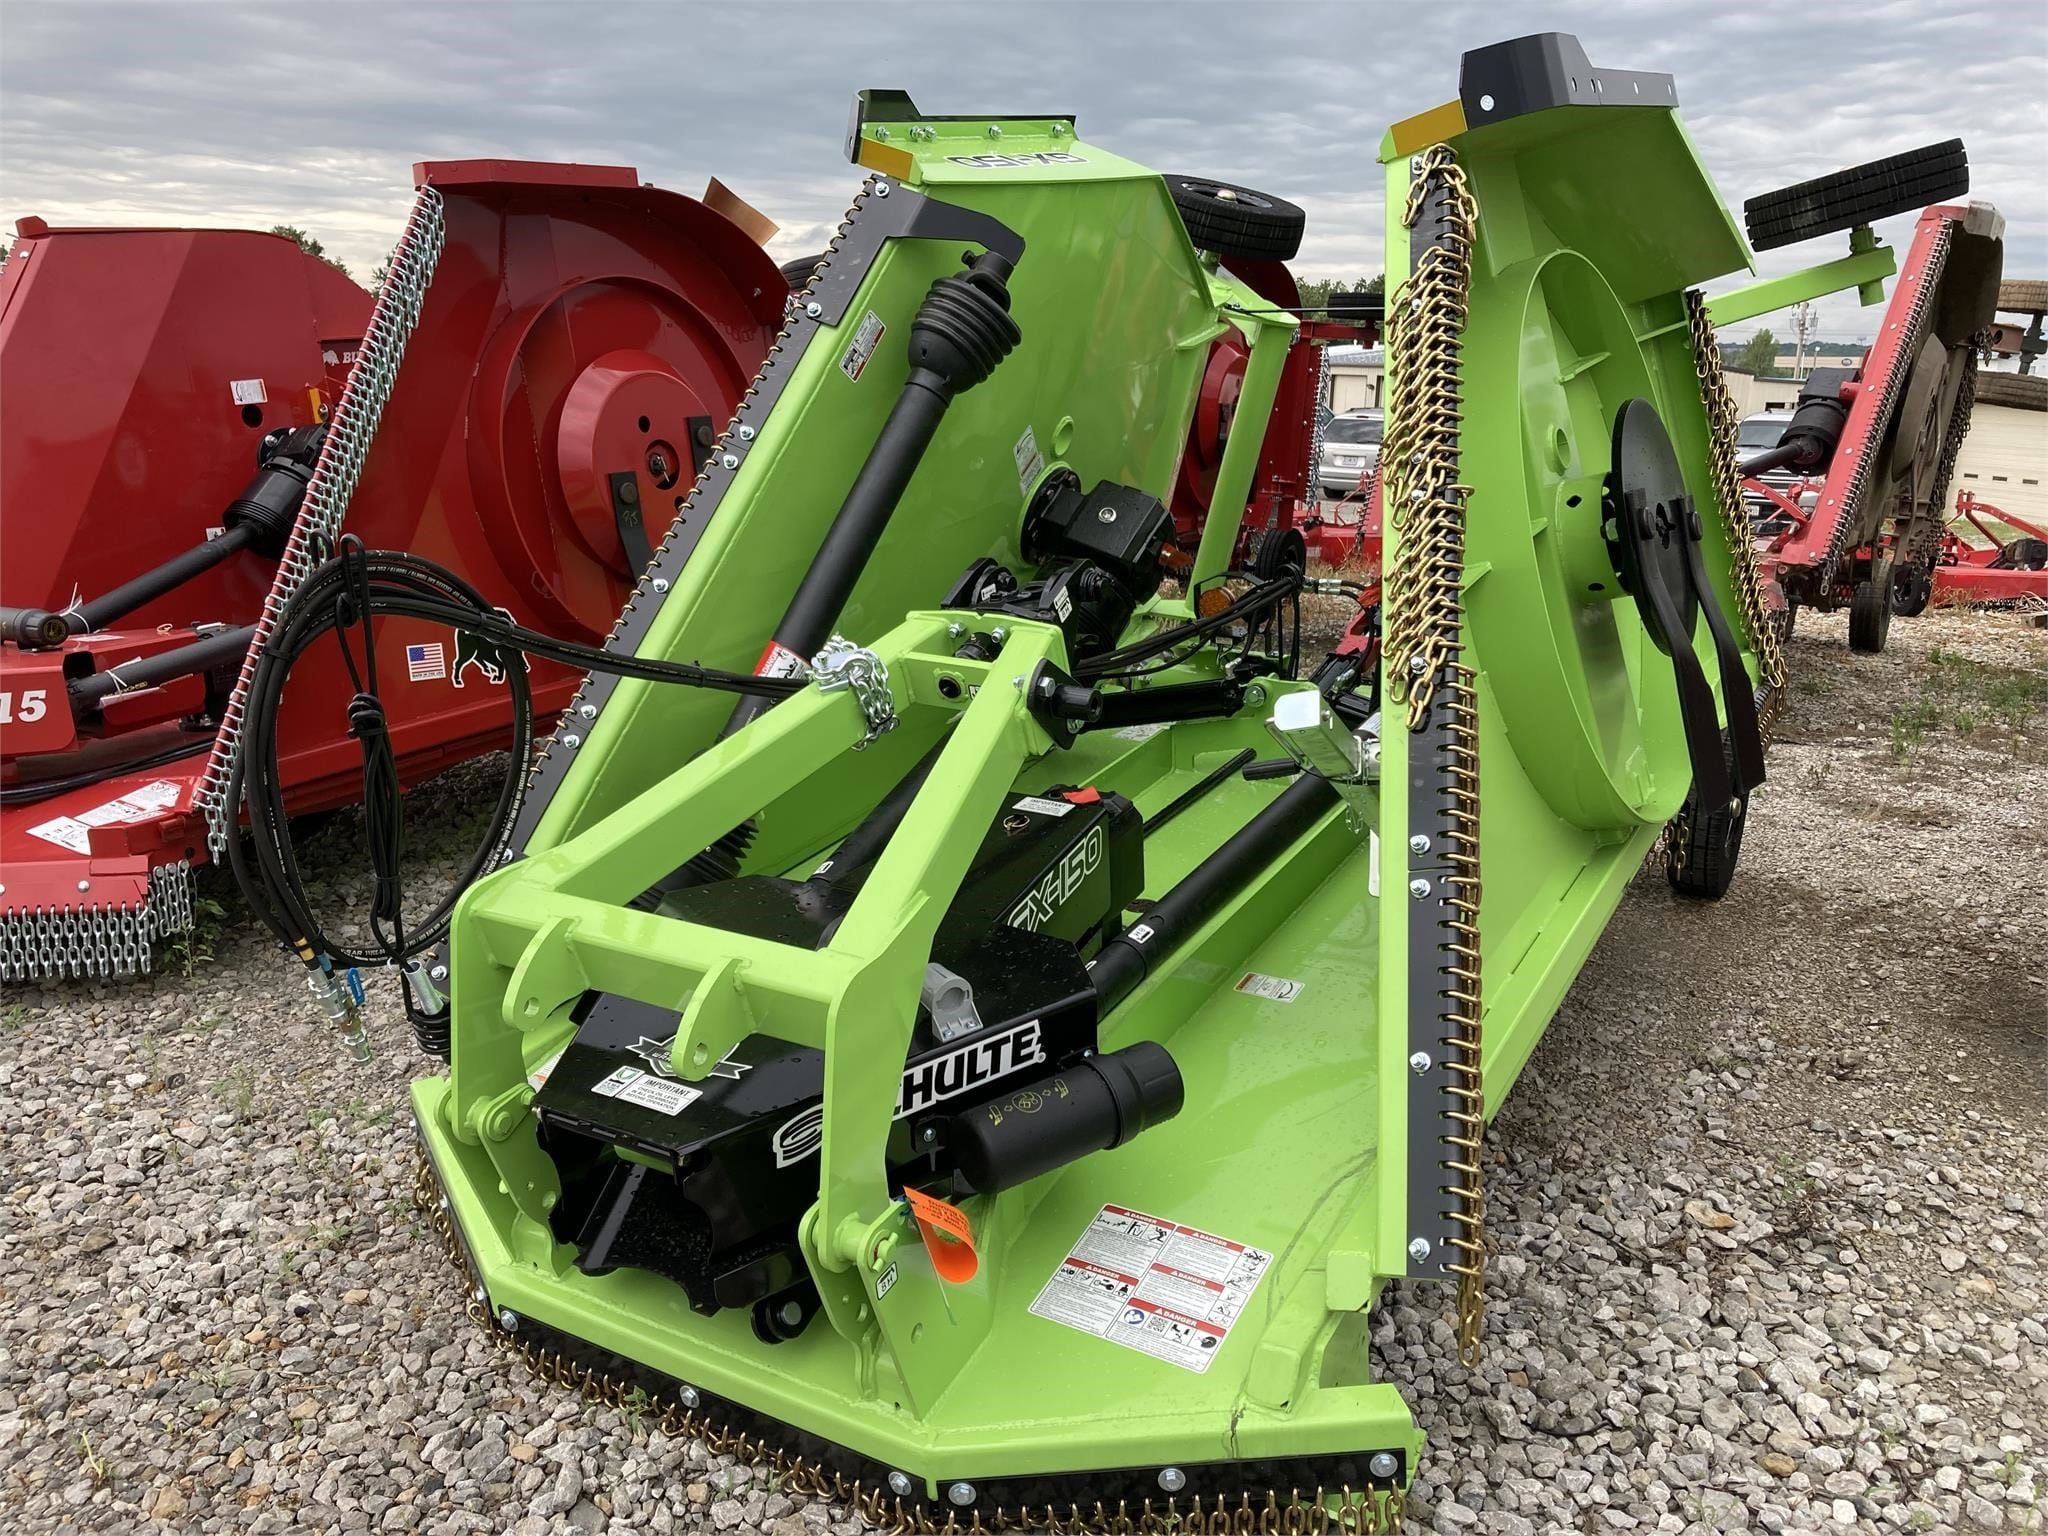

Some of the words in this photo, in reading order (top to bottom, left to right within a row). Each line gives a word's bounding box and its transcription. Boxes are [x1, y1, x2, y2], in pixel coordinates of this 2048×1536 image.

[637, 1086, 655, 1094] CHECK
[663, 1093, 680, 1102] LEVEL
[644, 1079, 691, 1096] IMPORTANT
[775, 1022, 1040, 1164] SHULTE
[625, 1092, 646, 1101] BEFORE
[646, 1099, 675, 1110] OPERATION
[646, 1094, 679, 1106] GEARBOXES
[1130, 1211, 1157, 1225] DANGER
[1199, 1233, 1228, 1247] DANGER
[1093, 1266, 1120, 1280] DANGER
[1178, 1272, 1207, 1287] DANGER
[1163, 1311, 1198, 1328] DANGER
